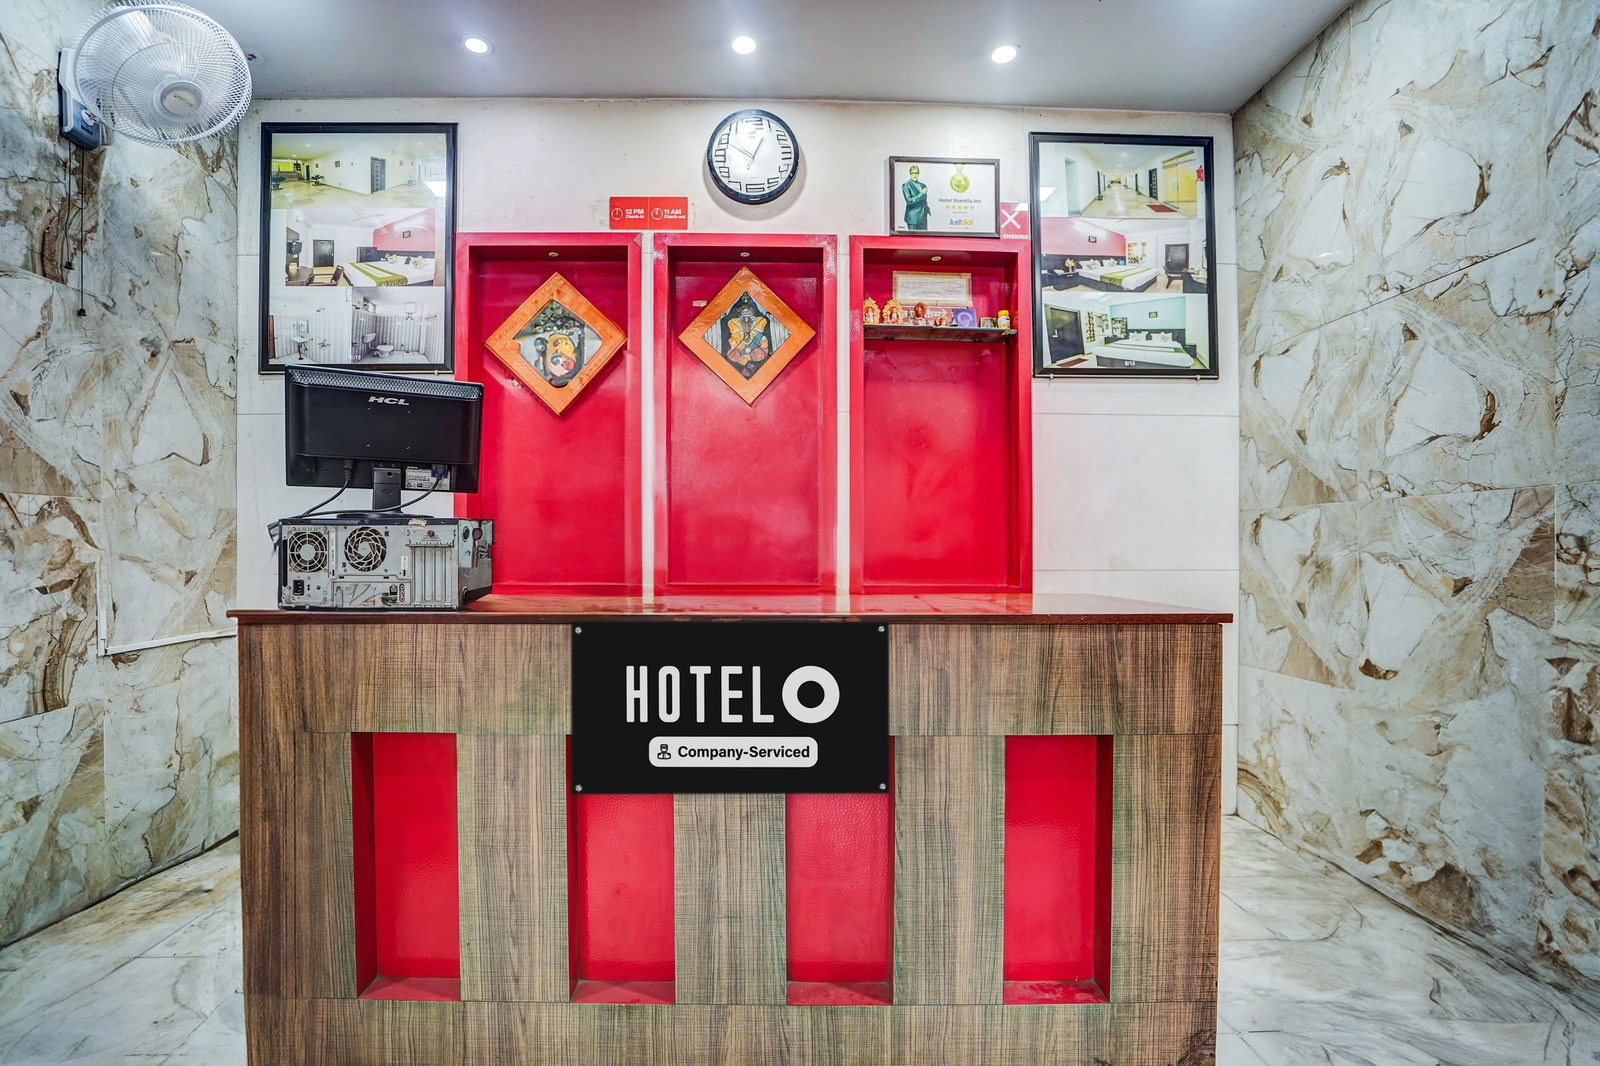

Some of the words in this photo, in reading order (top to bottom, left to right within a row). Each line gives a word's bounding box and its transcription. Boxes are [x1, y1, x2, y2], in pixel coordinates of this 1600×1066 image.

[368, 396, 410, 406] HCL
[625, 665, 775, 723] HOTEL
[677, 745, 810, 761] Company-Serviced
